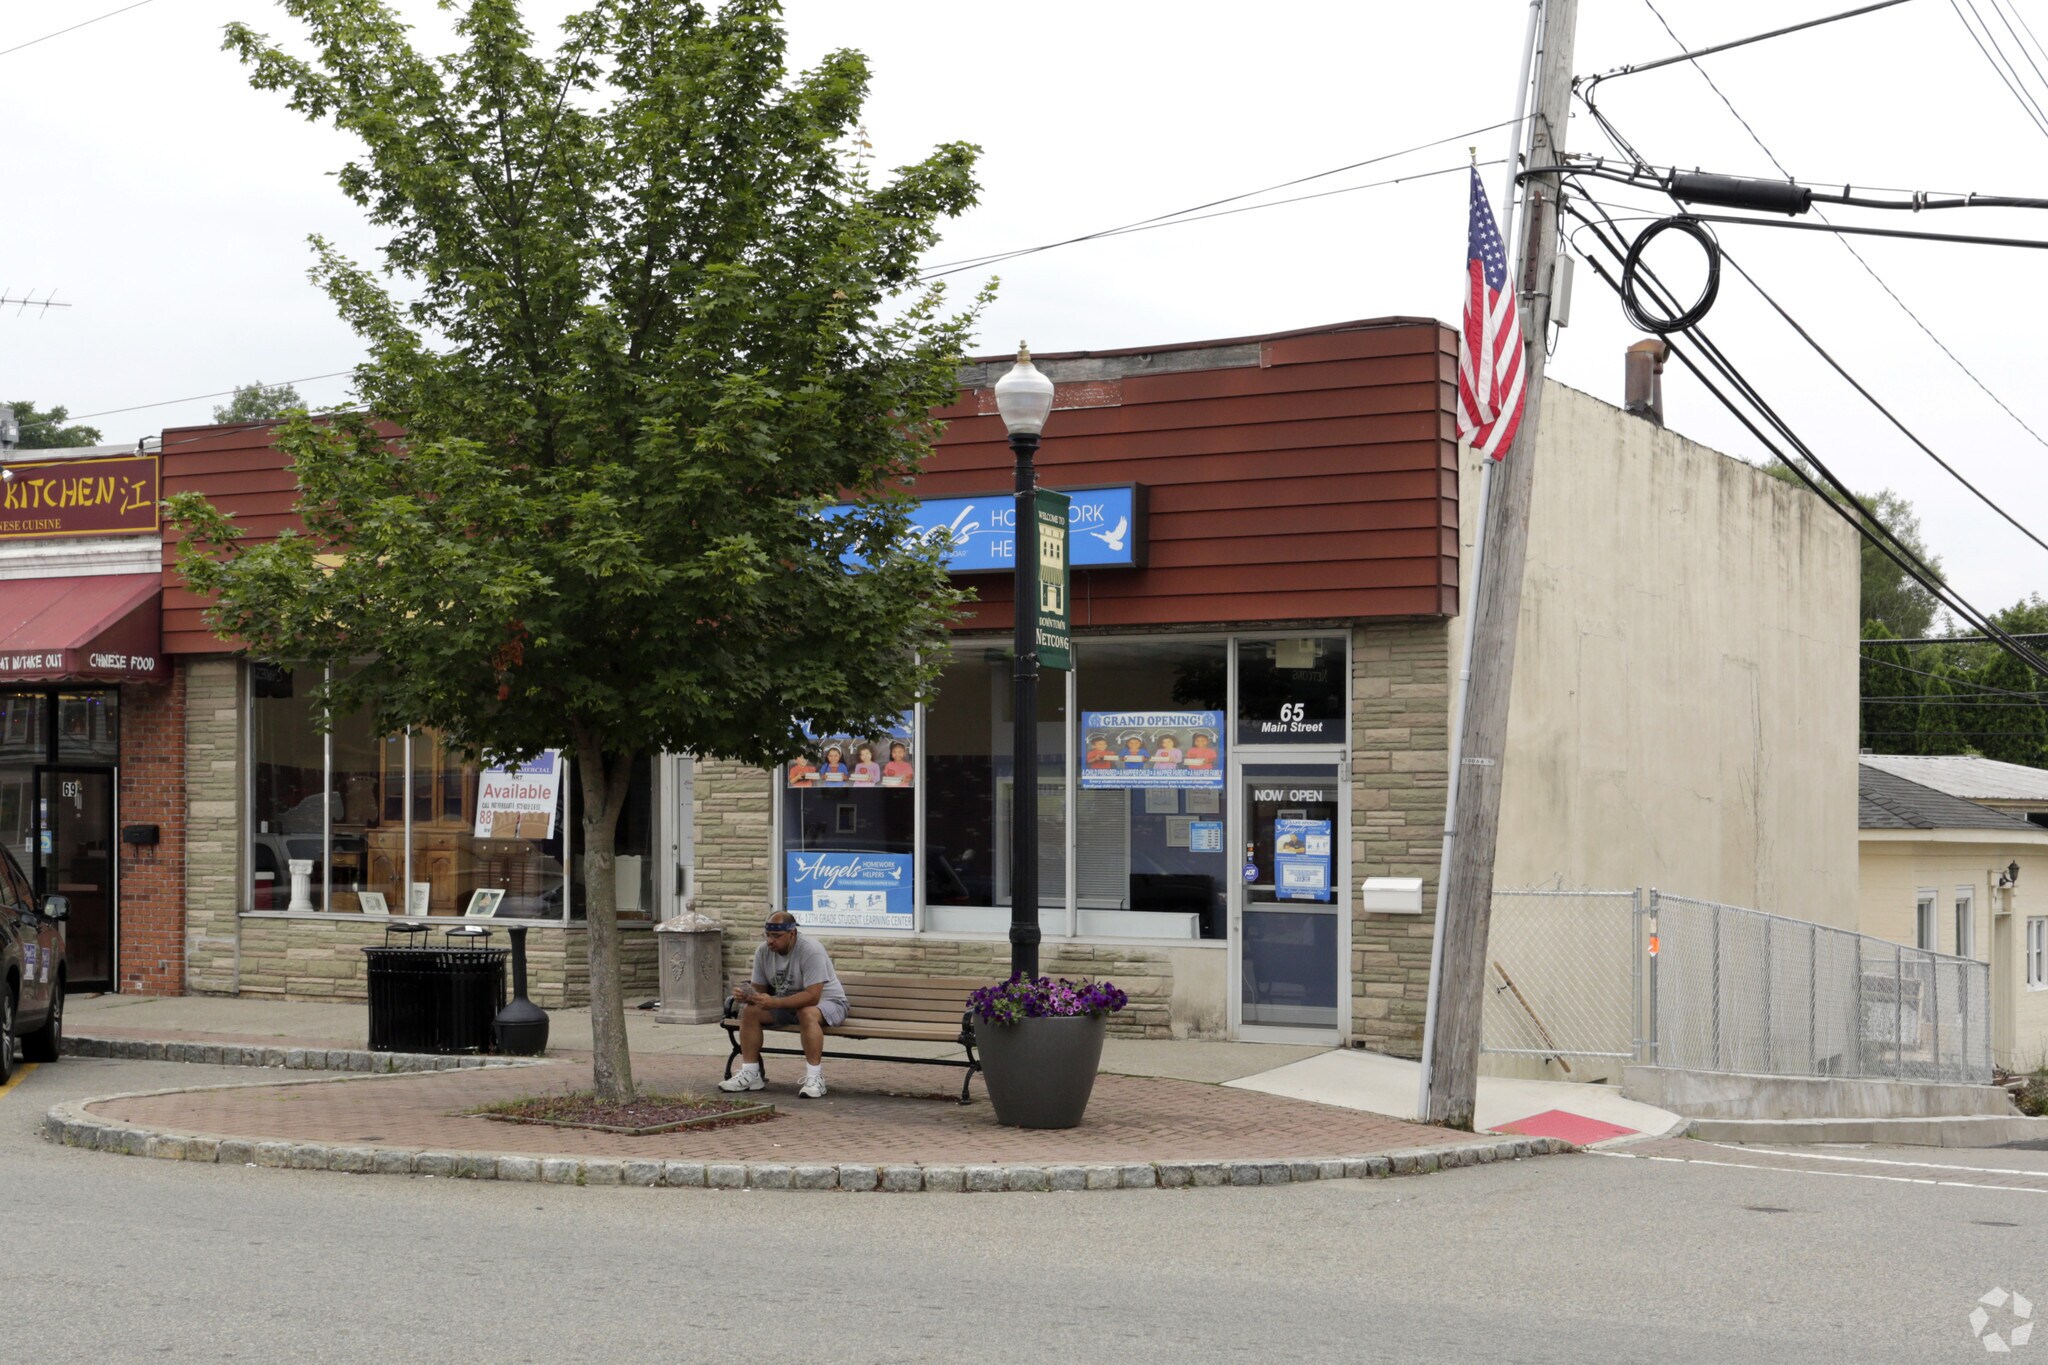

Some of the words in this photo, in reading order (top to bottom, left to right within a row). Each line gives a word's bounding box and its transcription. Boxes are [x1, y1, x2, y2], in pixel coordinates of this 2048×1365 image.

[4, 477, 115, 509] KITCHEN
[22, 519, 61, 530] CUISINE
[1039, 617, 1065, 630] DOWNTOWN
[45, 654, 62, 667] OUT
[90, 653, 126, 669] CHINESE
[131, 656, 154, 670] FOOD
[1280, 703, 1304, 722] 65
[1103, 715, 1145, 726] GRAND
[1147, 715, 1201, 726] OPENING!
[1261, 722, 1287, 733] Main
[1290, 722, 1323, 732] Street
[64, 783, 76, 796] 69
[483, 783, 551, 799] Available
[1255, 790, 1283, 801] NOW
[1289, 790, 1322, 802] OPEN
[795, 854, 862, 889] Angels
[805, 913, 818, 923] 12TH
[819, 913, 837, 924] GRADE
[837, 914, 862, 925] STUDENT
[863, 914, 890, 926] LEARNING
[891, 915, 912, 926] CENTER
